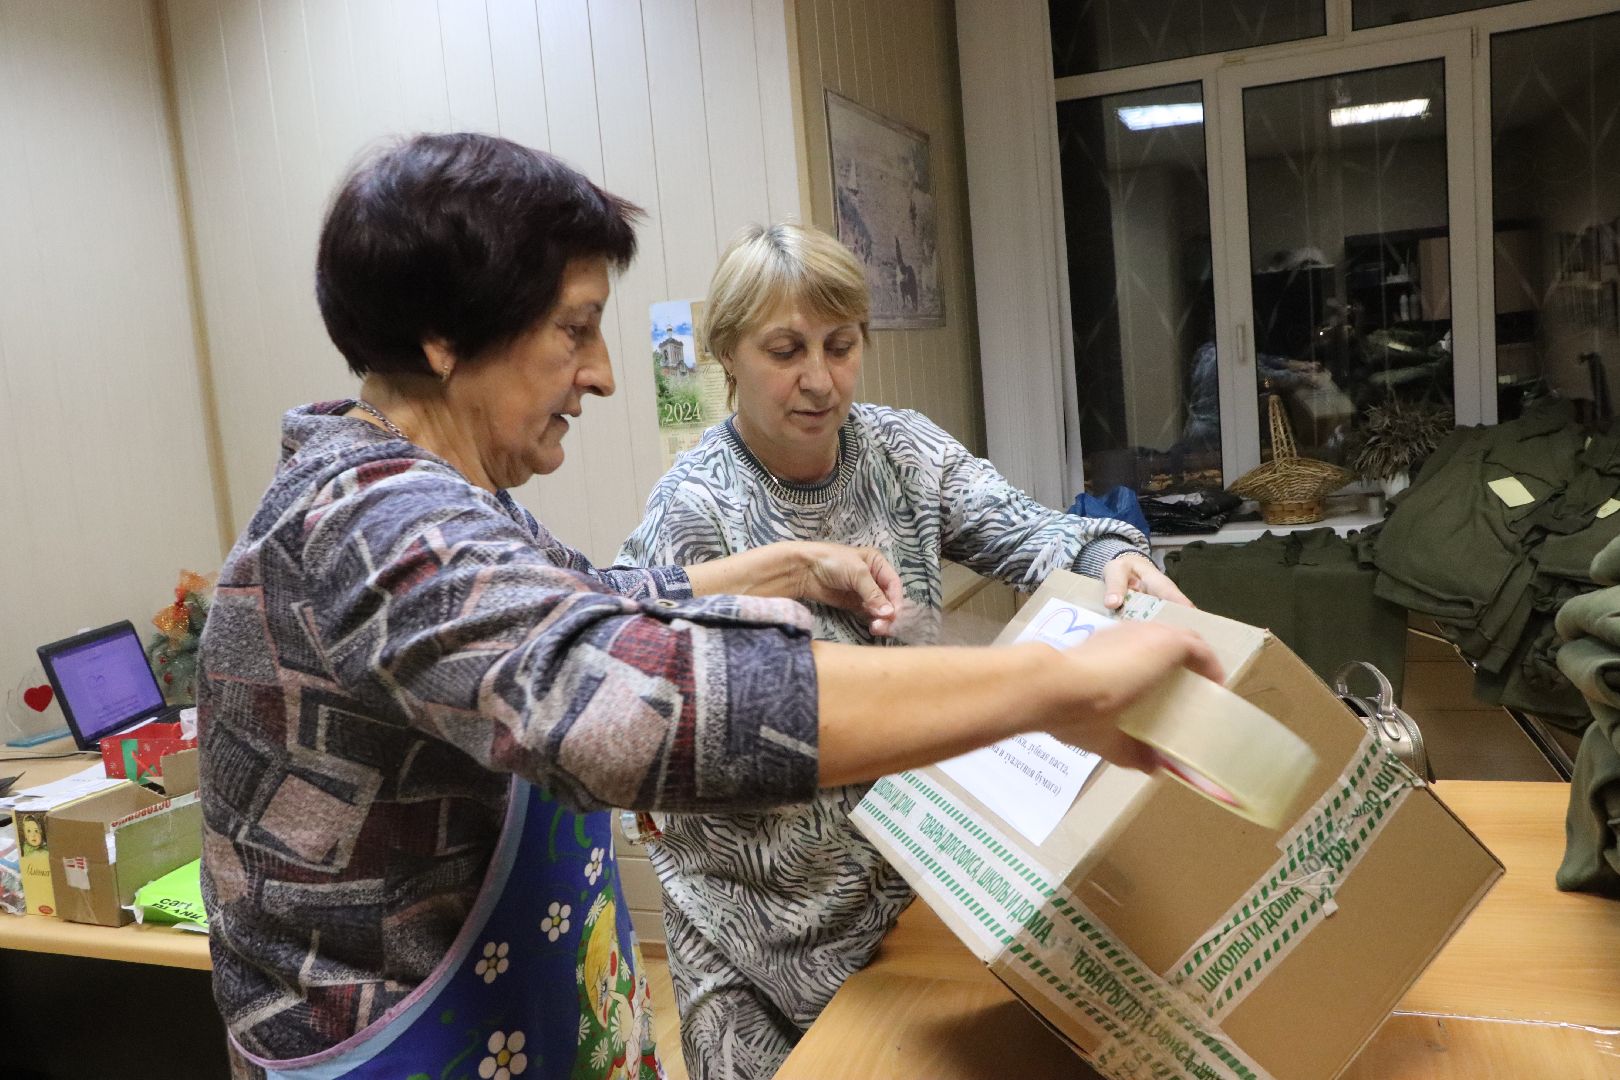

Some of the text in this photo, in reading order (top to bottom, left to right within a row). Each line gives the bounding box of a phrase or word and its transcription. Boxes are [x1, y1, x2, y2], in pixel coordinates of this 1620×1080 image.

[664, 402, 702, 424] 2024
[1049, 756, 1069, 776] паста,
[1035, 770, 1062, 797] бумага)
[918, 812, 949, 845] ТОВАРЫ
[936, 831, 962, 857] ДЛЯ
[975, 866, 1015, 905] ШКОЛЫ
[1003, 891, 1022, 911] И
[1007, 898, 1057, 944] ДОМА
[1197, 930, 1253, 993] ШКОЛЫ
[1247, 921, 1265, 940] И
[1260, 886, 1304, 934] ДОМА
[1070, 949, 1129, 1007] ТОВАРЫ
